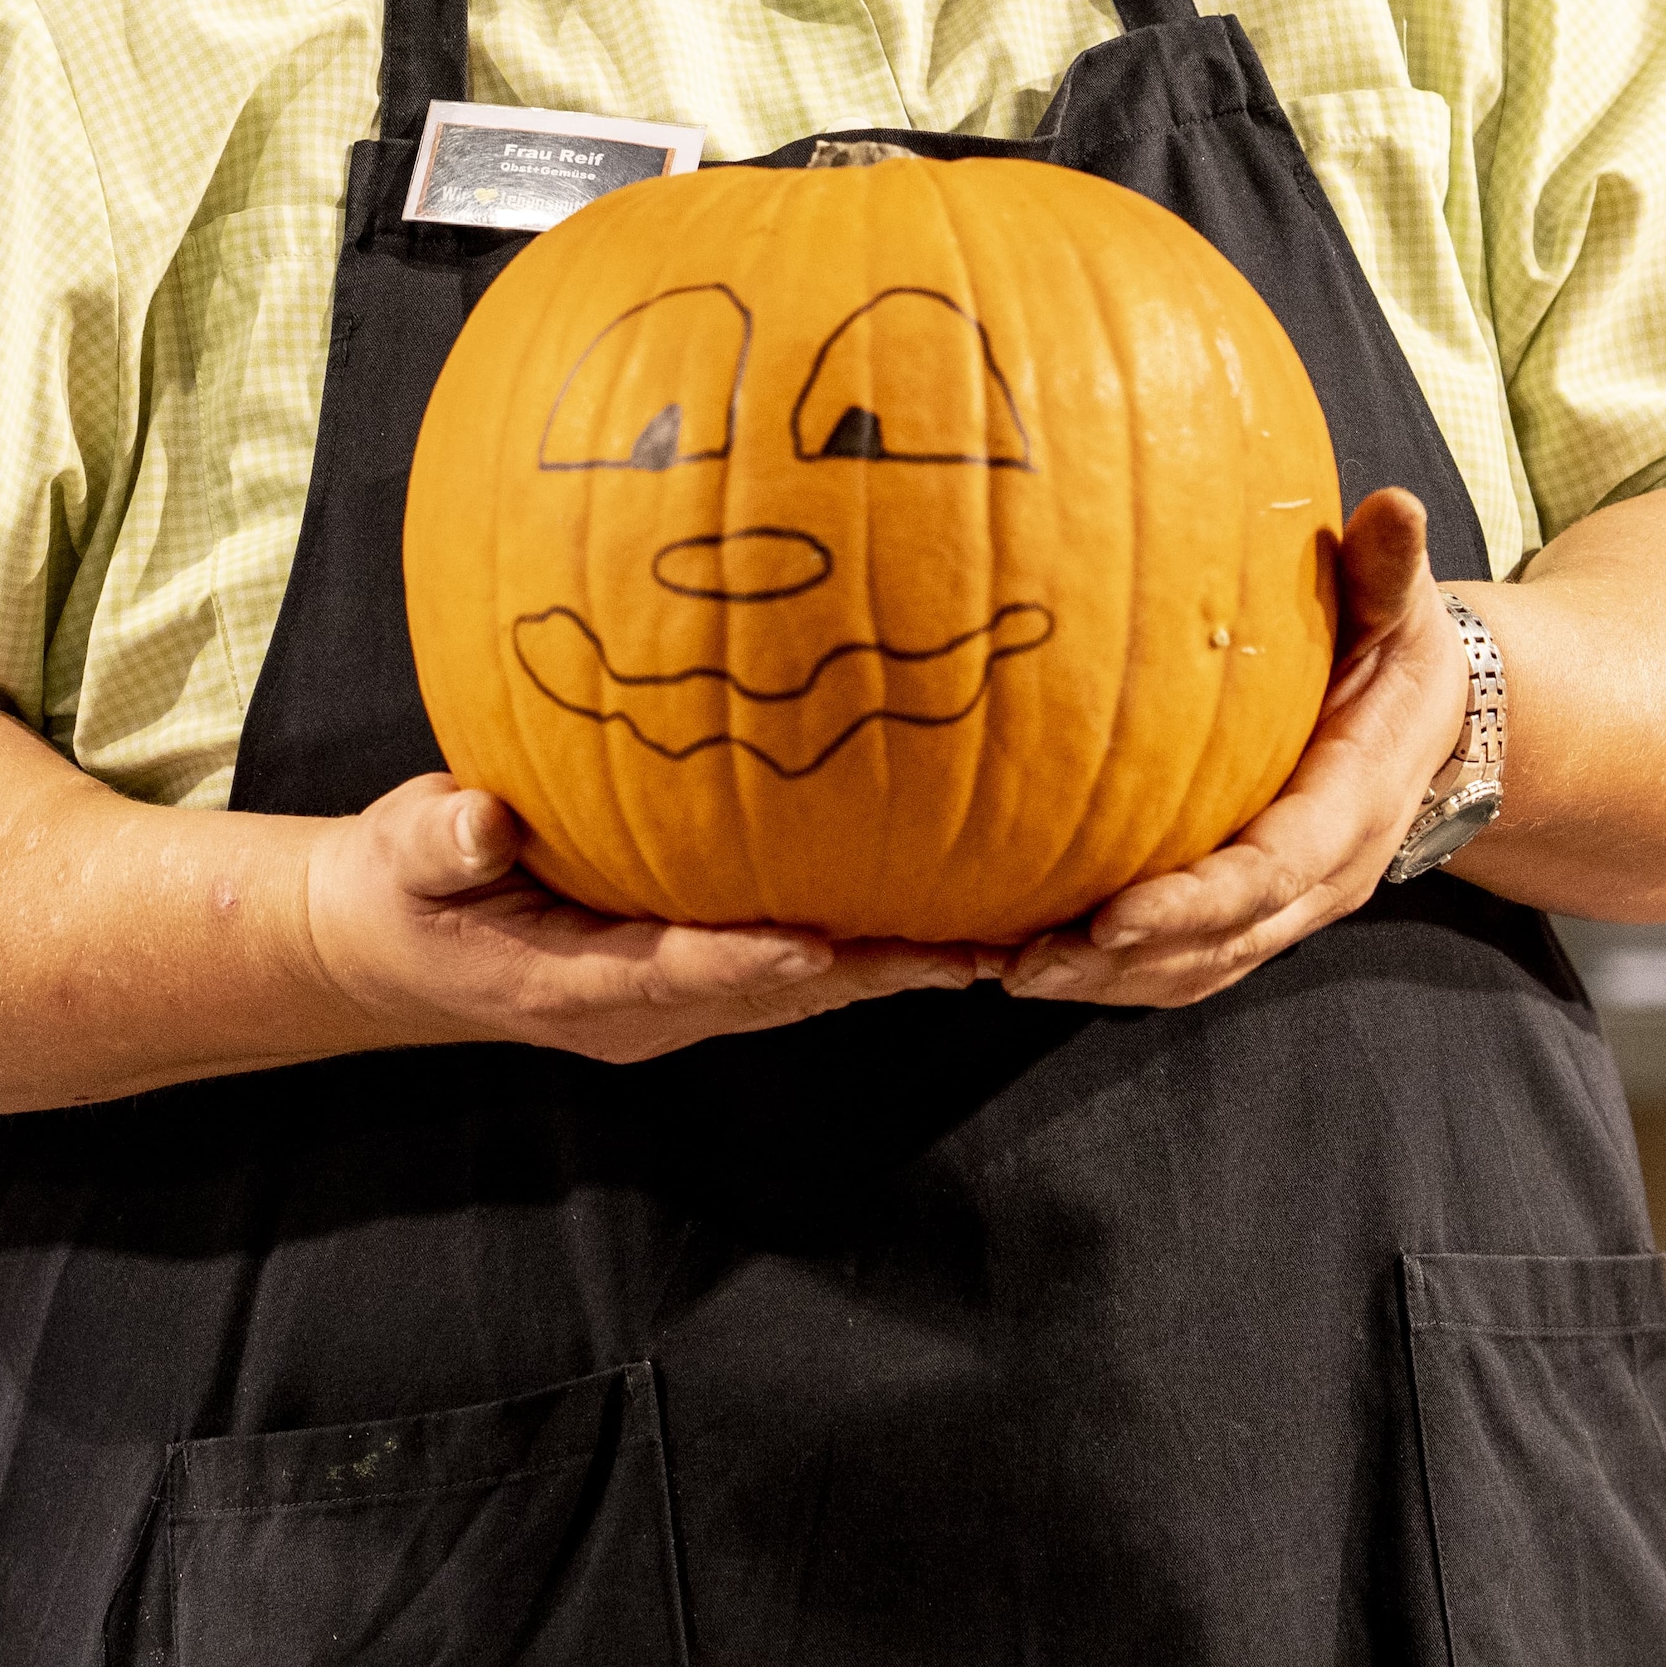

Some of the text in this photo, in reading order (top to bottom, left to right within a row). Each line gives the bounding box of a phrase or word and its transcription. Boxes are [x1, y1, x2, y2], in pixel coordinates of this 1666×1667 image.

[503, 143, 605, 166] Frau Reif
[500, 162, 596, 181] Obst+Gemüse
